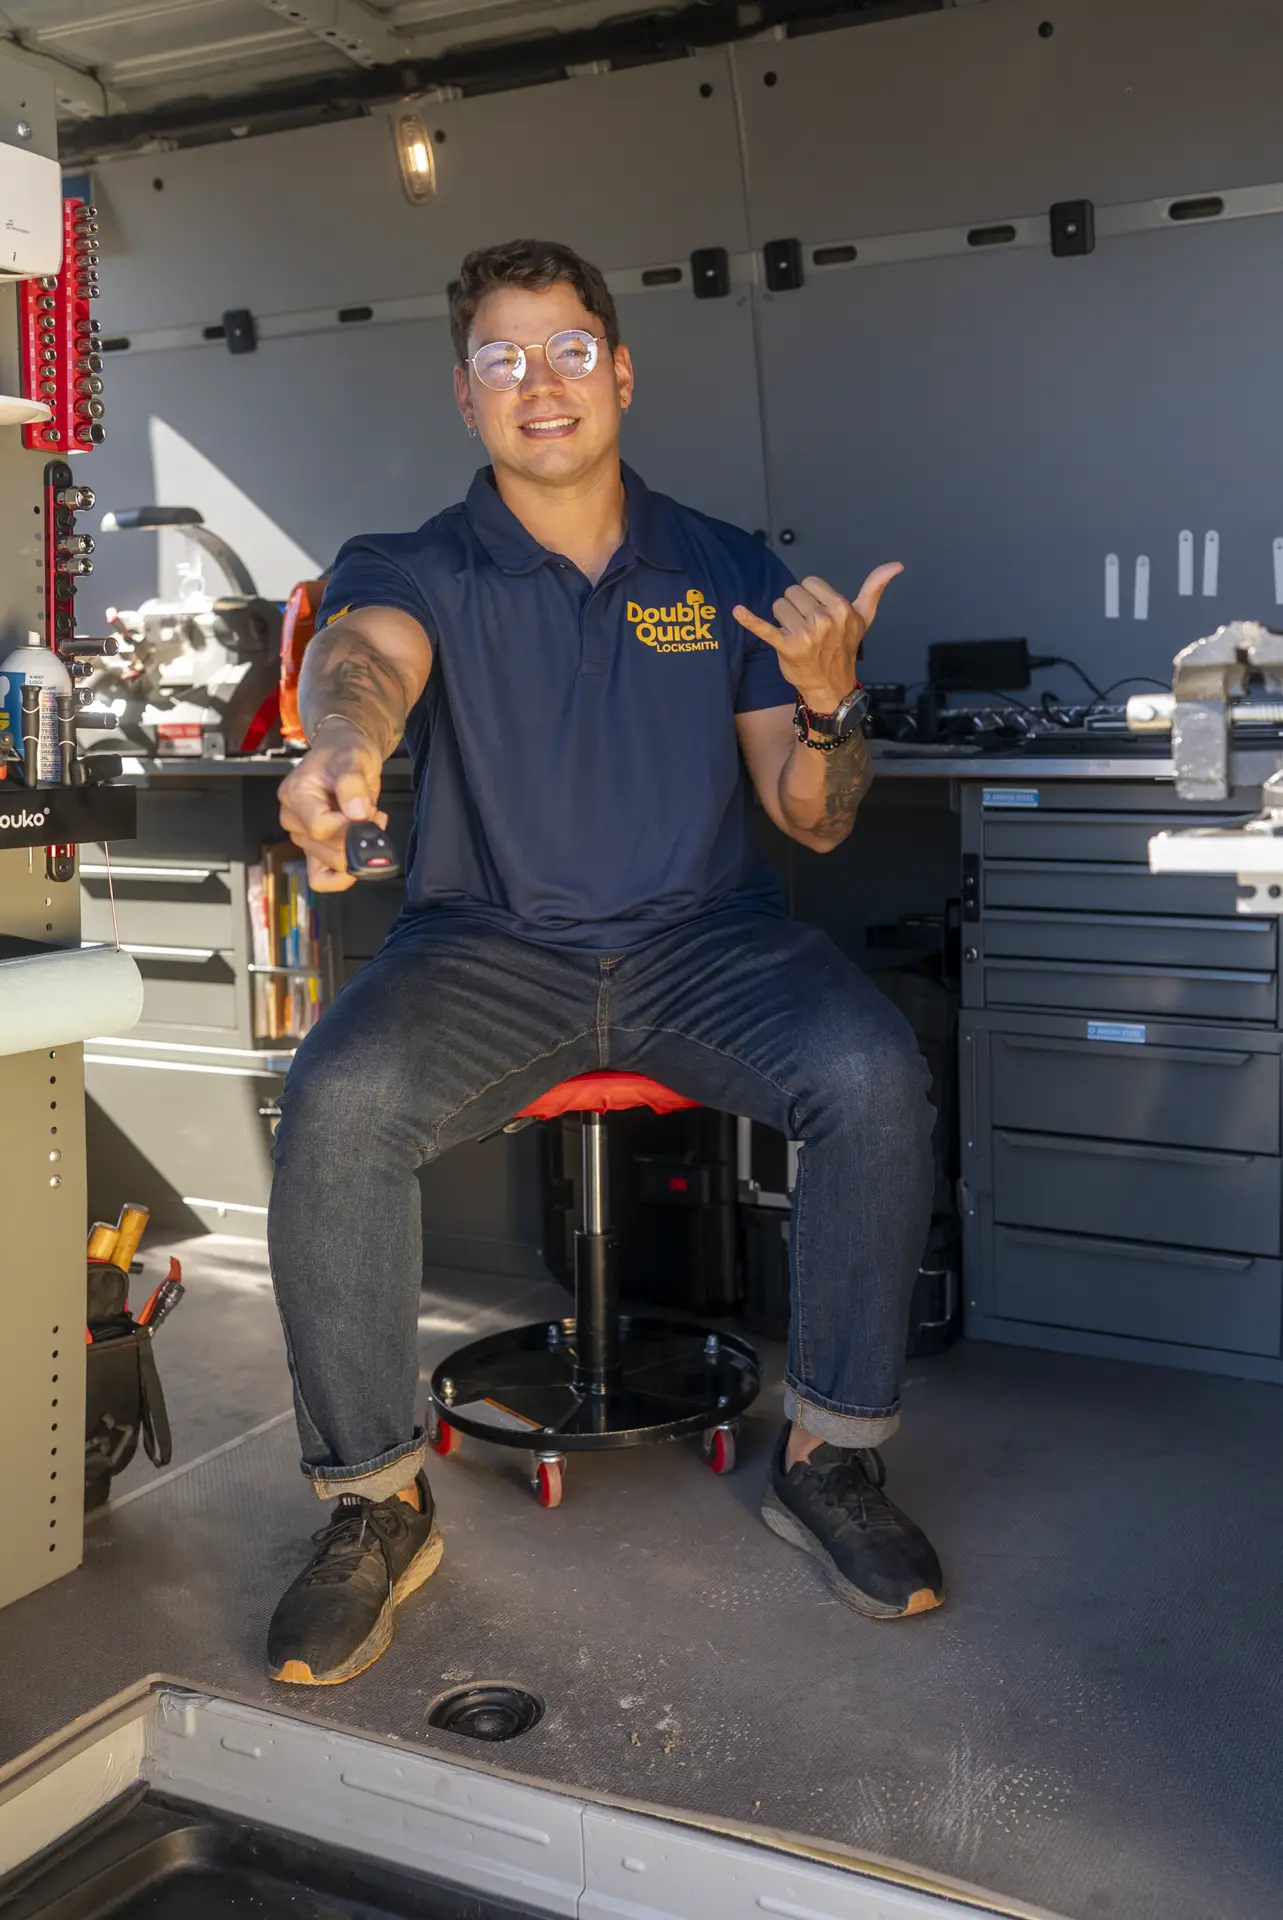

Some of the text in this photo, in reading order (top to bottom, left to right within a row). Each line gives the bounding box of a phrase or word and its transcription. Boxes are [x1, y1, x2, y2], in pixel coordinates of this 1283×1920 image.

[627, 600, 717, 623] Double
[636, 622, 713, 647] Quick
[656, 641, 719, 653] LOCKSMITH
